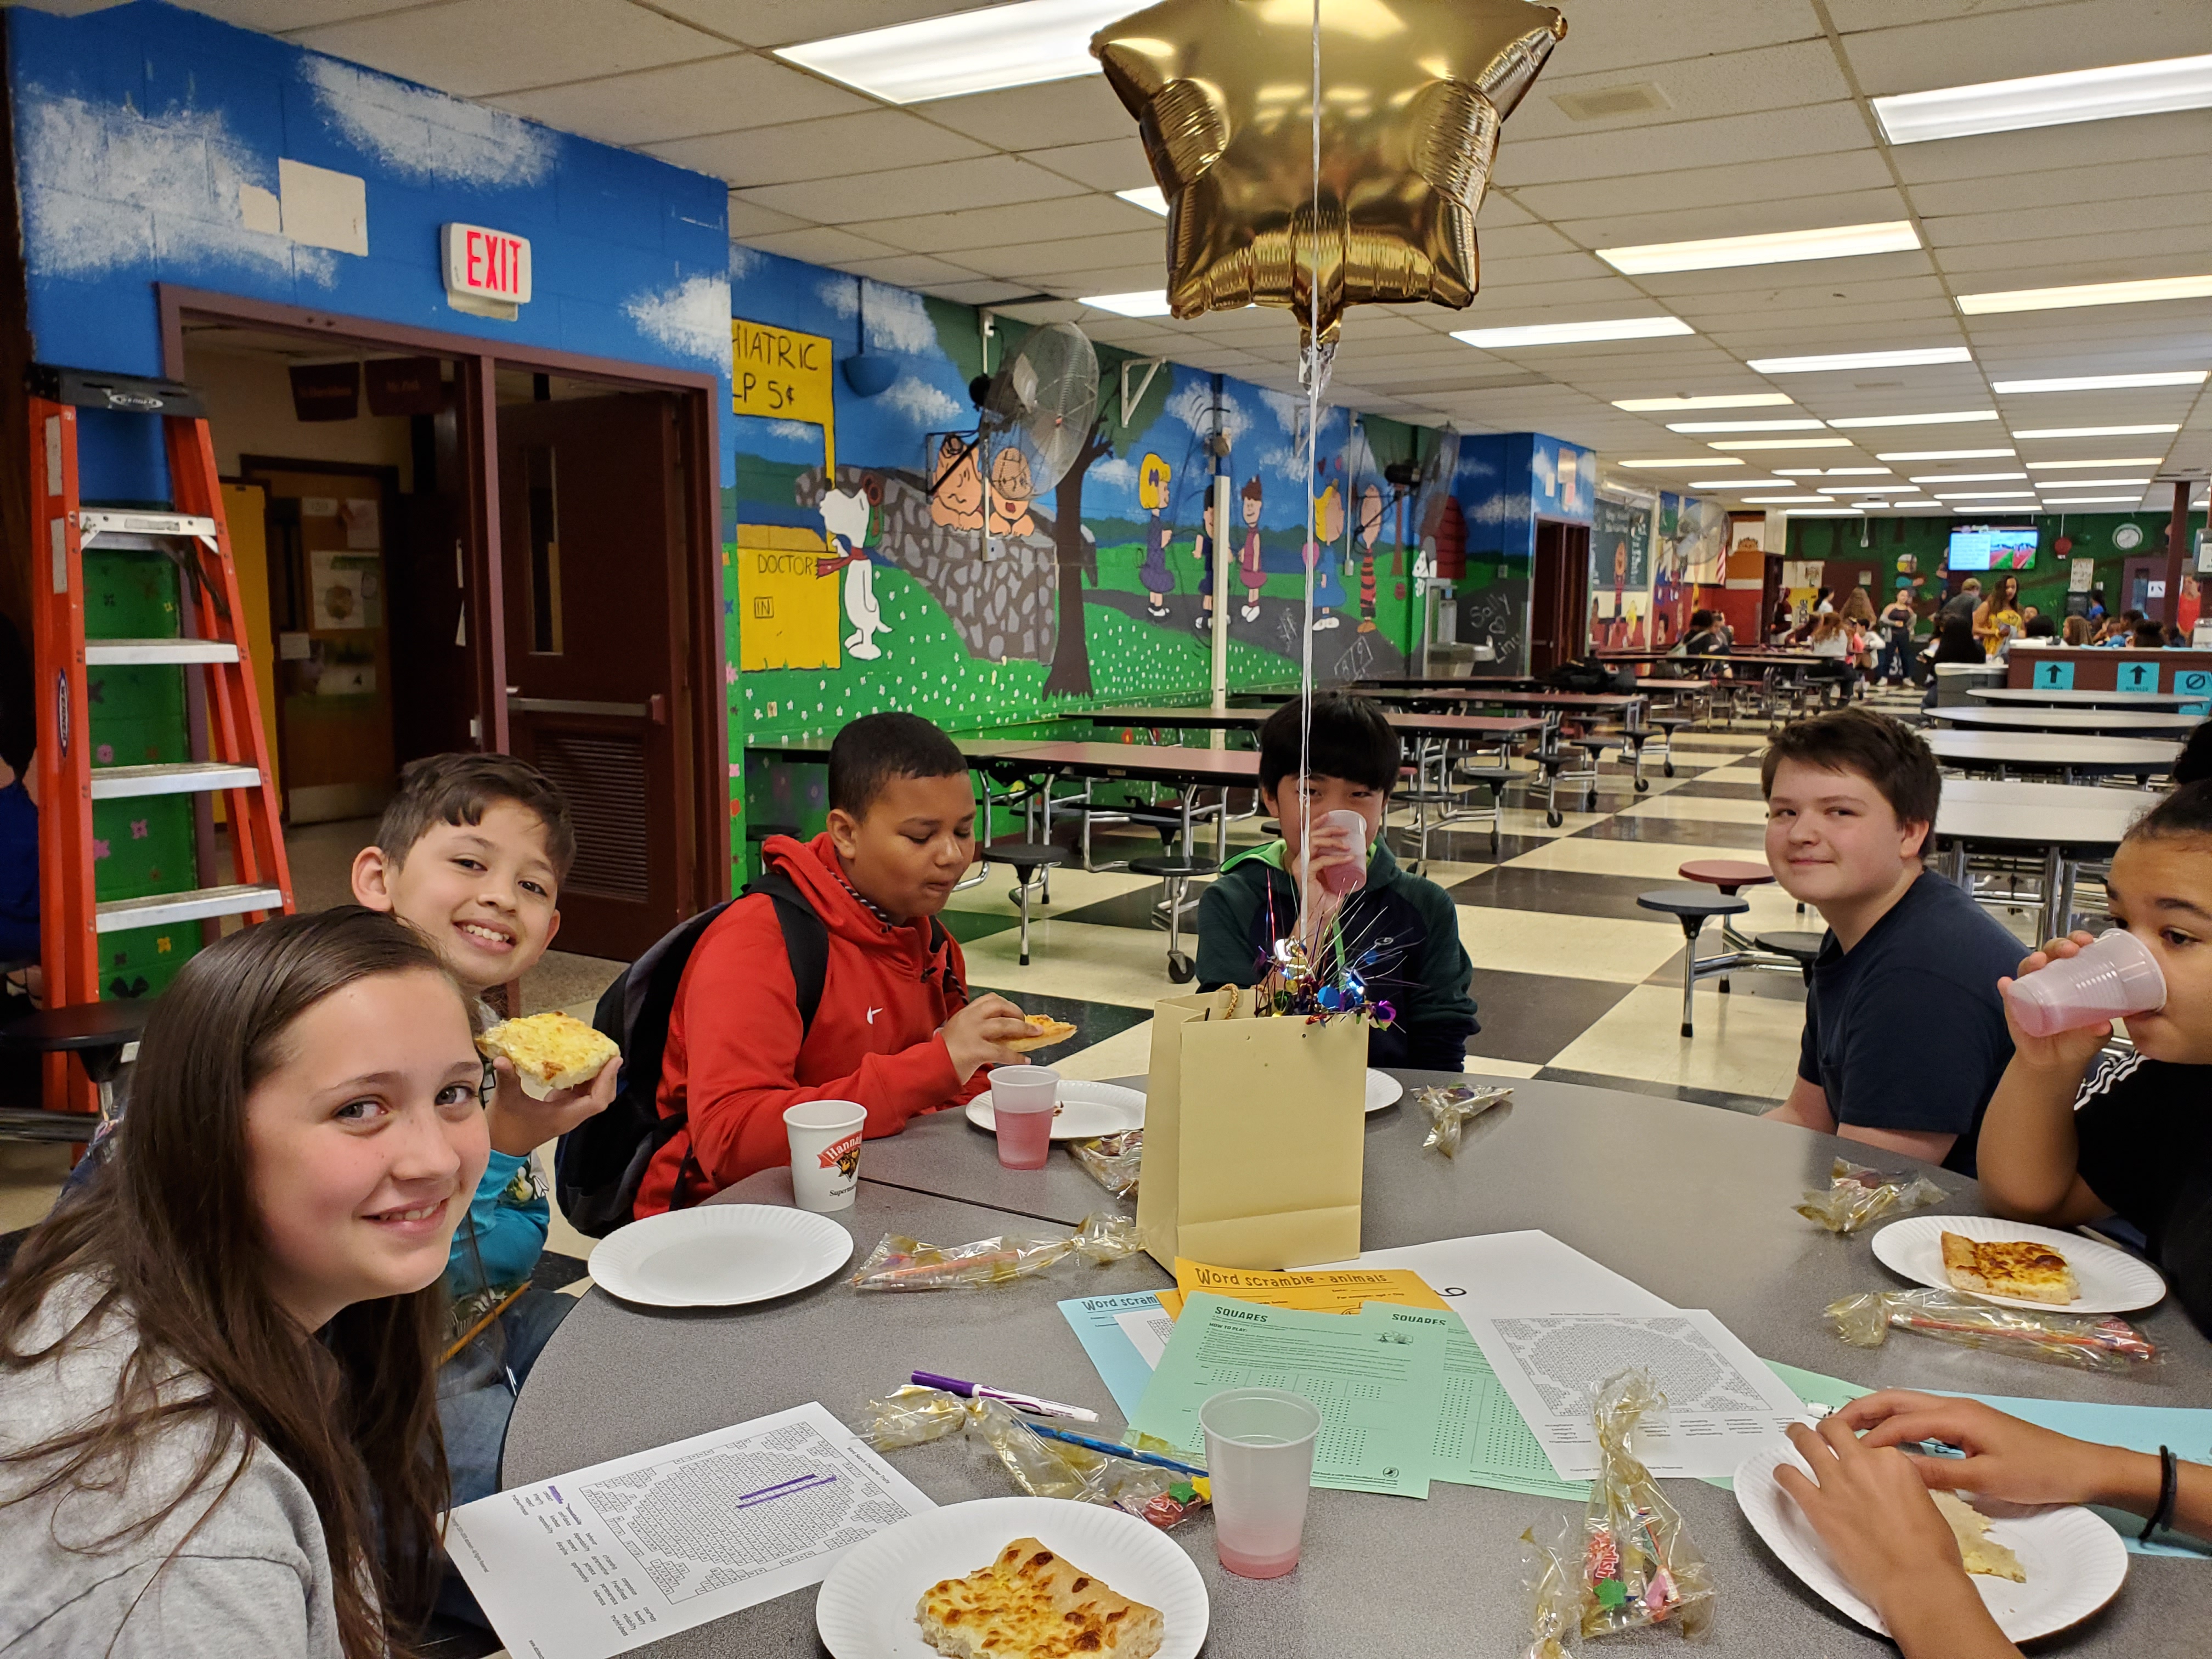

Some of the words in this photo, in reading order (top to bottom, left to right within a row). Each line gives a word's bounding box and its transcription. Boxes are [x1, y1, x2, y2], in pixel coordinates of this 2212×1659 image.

[466, 230, 522, 294] EXIT
[768, 380, 794, 409] 5¢
[758, 554, 814, 576] DOCTOR
[757, 599, 770, 616] IN
[1469, 592, 1511, 628] Sally
[1195, 1267, 1240, 1285] Word
[1245, 1274, 1315, 1288] scramble
[1330, 1273, 1388, 1284] animals
[1081, 1298, 1119, 1311] Word
[1214, 1306, 1269, 1323] SQUARES
[633, 1610, 647, 1626] honesty
[642, 1606, 657, 1622] courtesy
